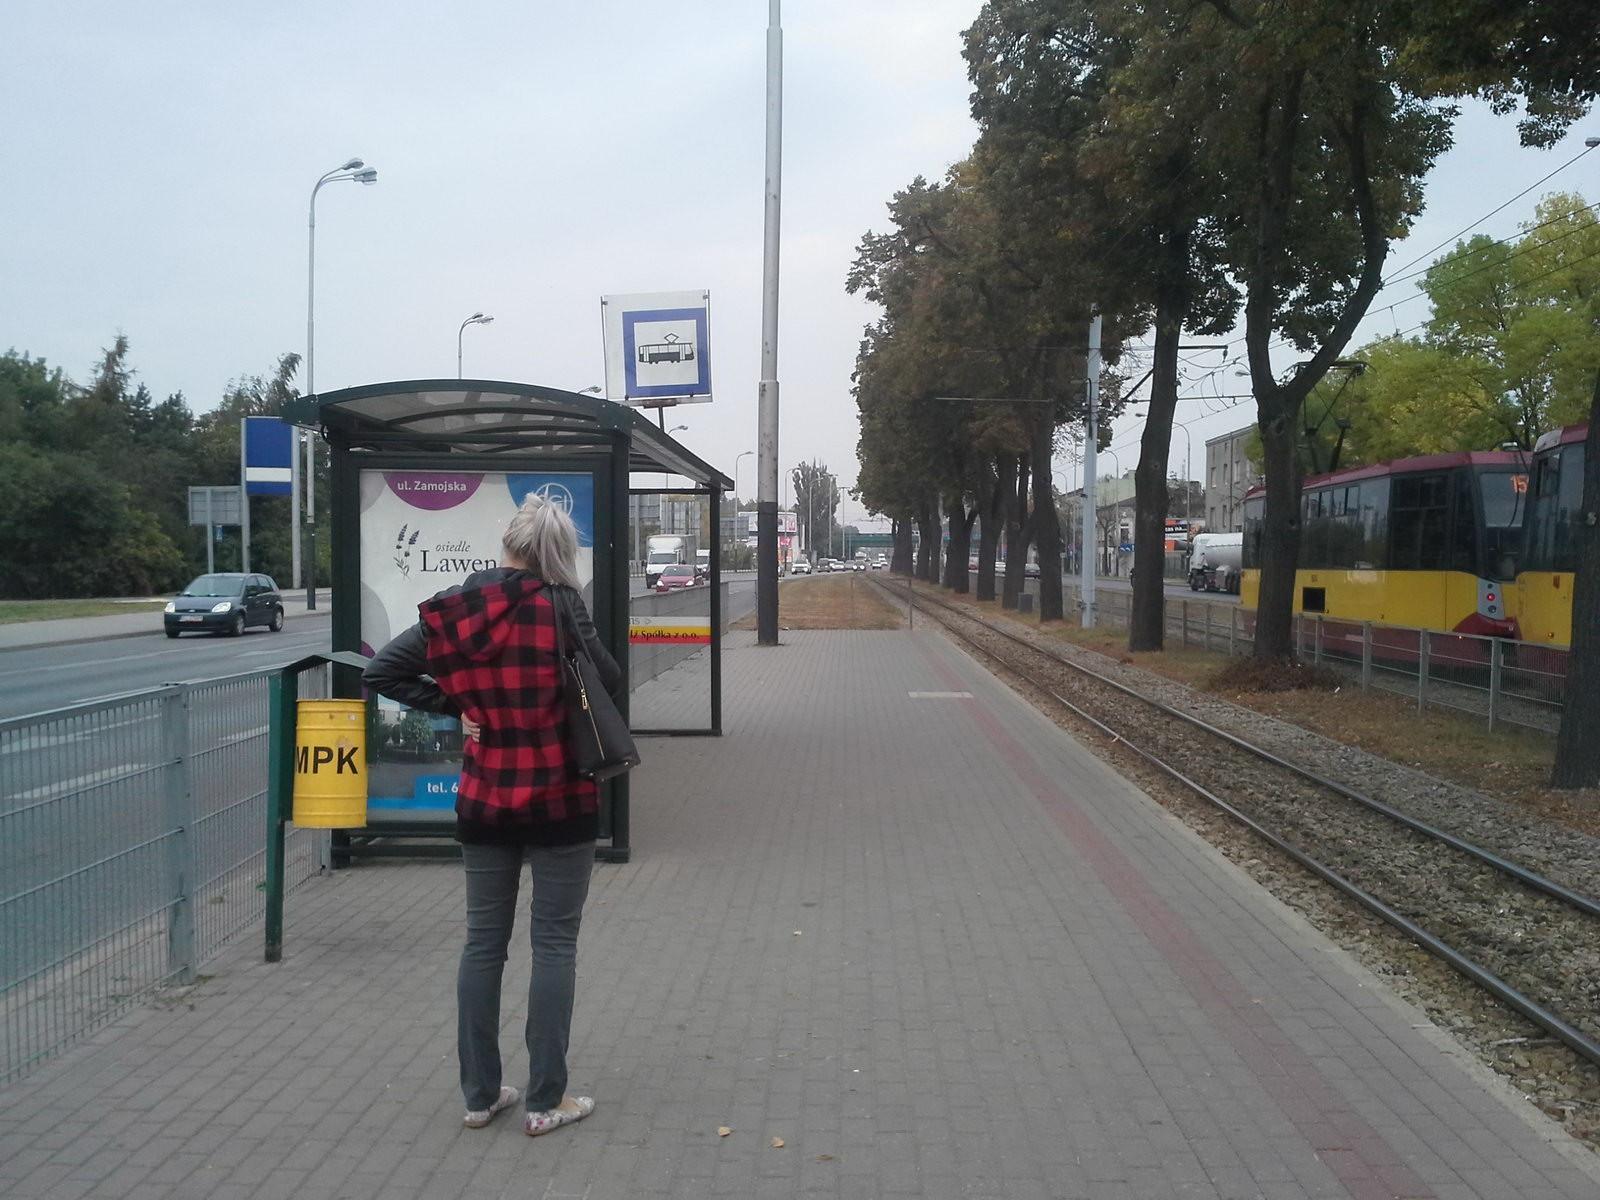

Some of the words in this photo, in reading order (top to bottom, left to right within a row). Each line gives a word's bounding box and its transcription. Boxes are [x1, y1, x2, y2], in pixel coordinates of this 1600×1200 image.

[397, 481, 411, 491] ul.
[414, 481, 467, 493] Zamojska
[1510, 474, 1529, 493] 15
[435, 540, 471, 552] osiedle
[420, 549, 497, 573] Lawen
[641, 629, 671, 640] Spółka
[297, 746, 359, 775] MPK
[427, 781, 448, 793] tel.
[451, 781, 459, 793] 6
